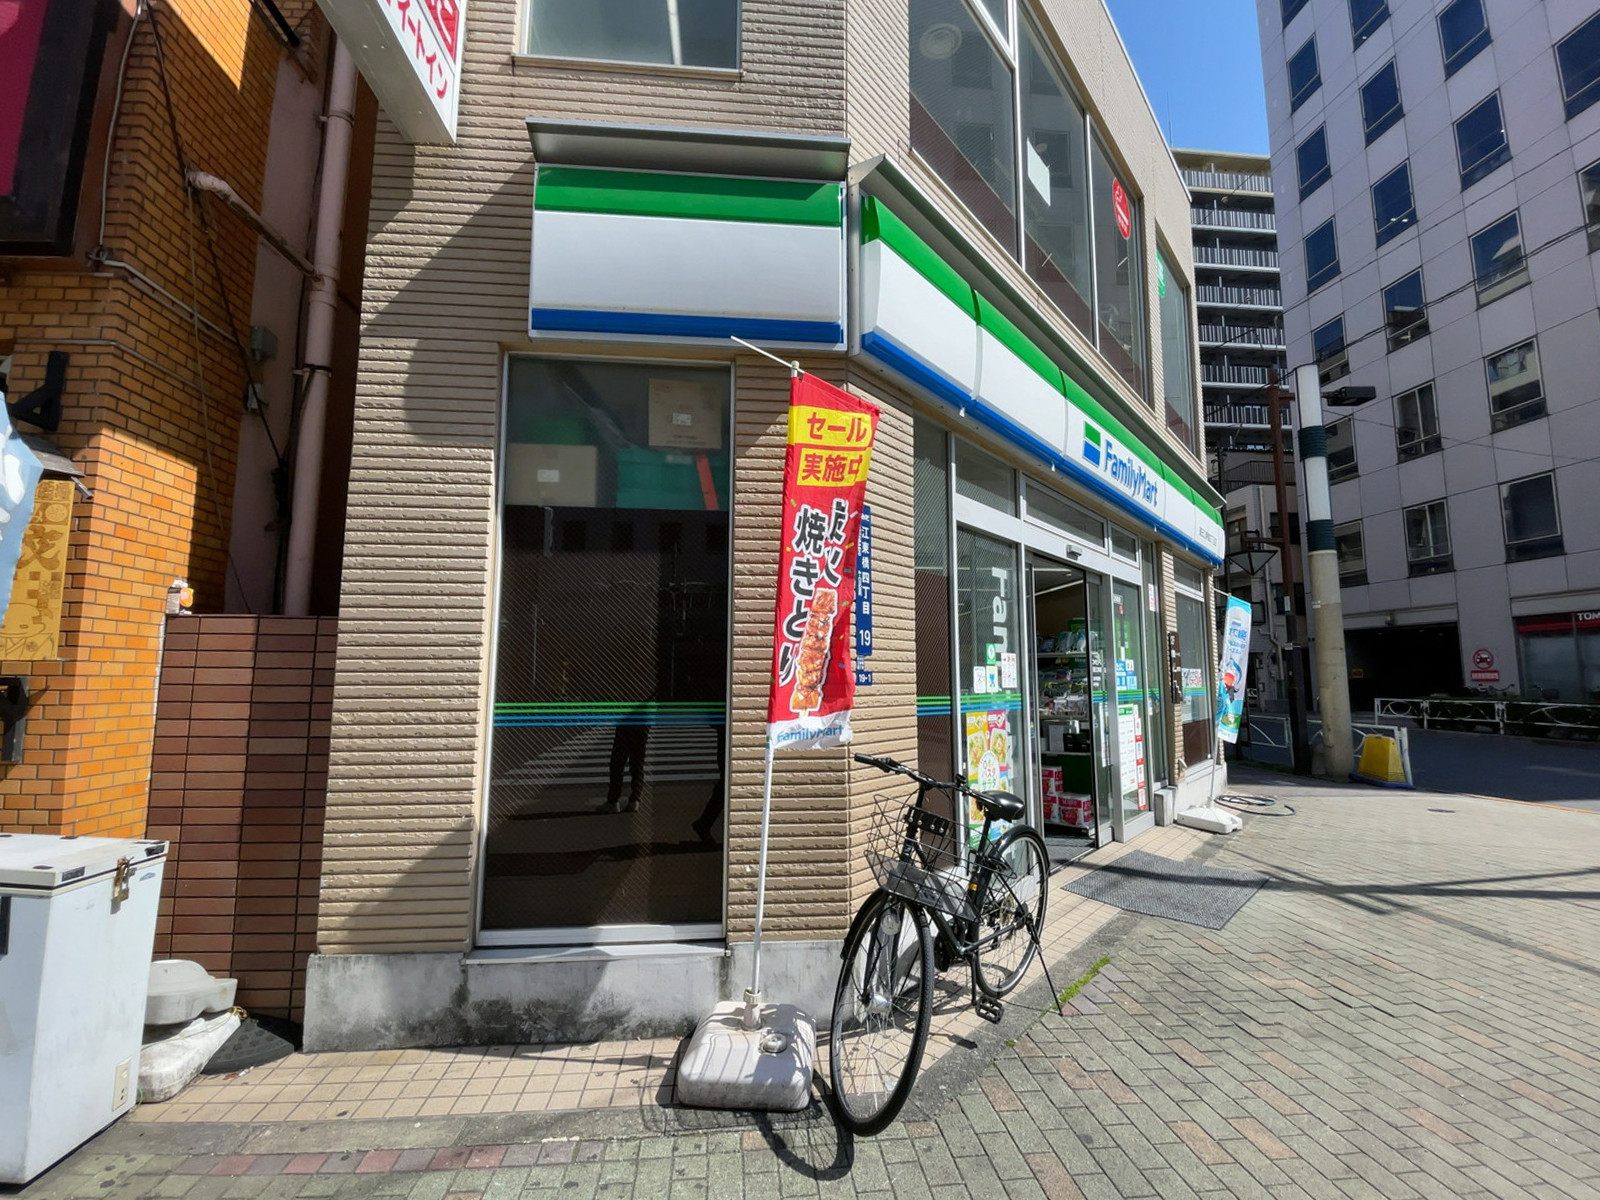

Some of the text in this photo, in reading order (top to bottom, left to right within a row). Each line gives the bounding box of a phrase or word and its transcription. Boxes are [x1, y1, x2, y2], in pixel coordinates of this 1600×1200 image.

[806, 411, 867, 442] セール
[1104, 440, 1158, 507] FamilyMart
[779, 506, 827, 684] 焼きとり
[859, 629, 871, 646] 19
[858, 673, 872, 683] 19-1
[776, 725, 843, 743] FamilyMart
